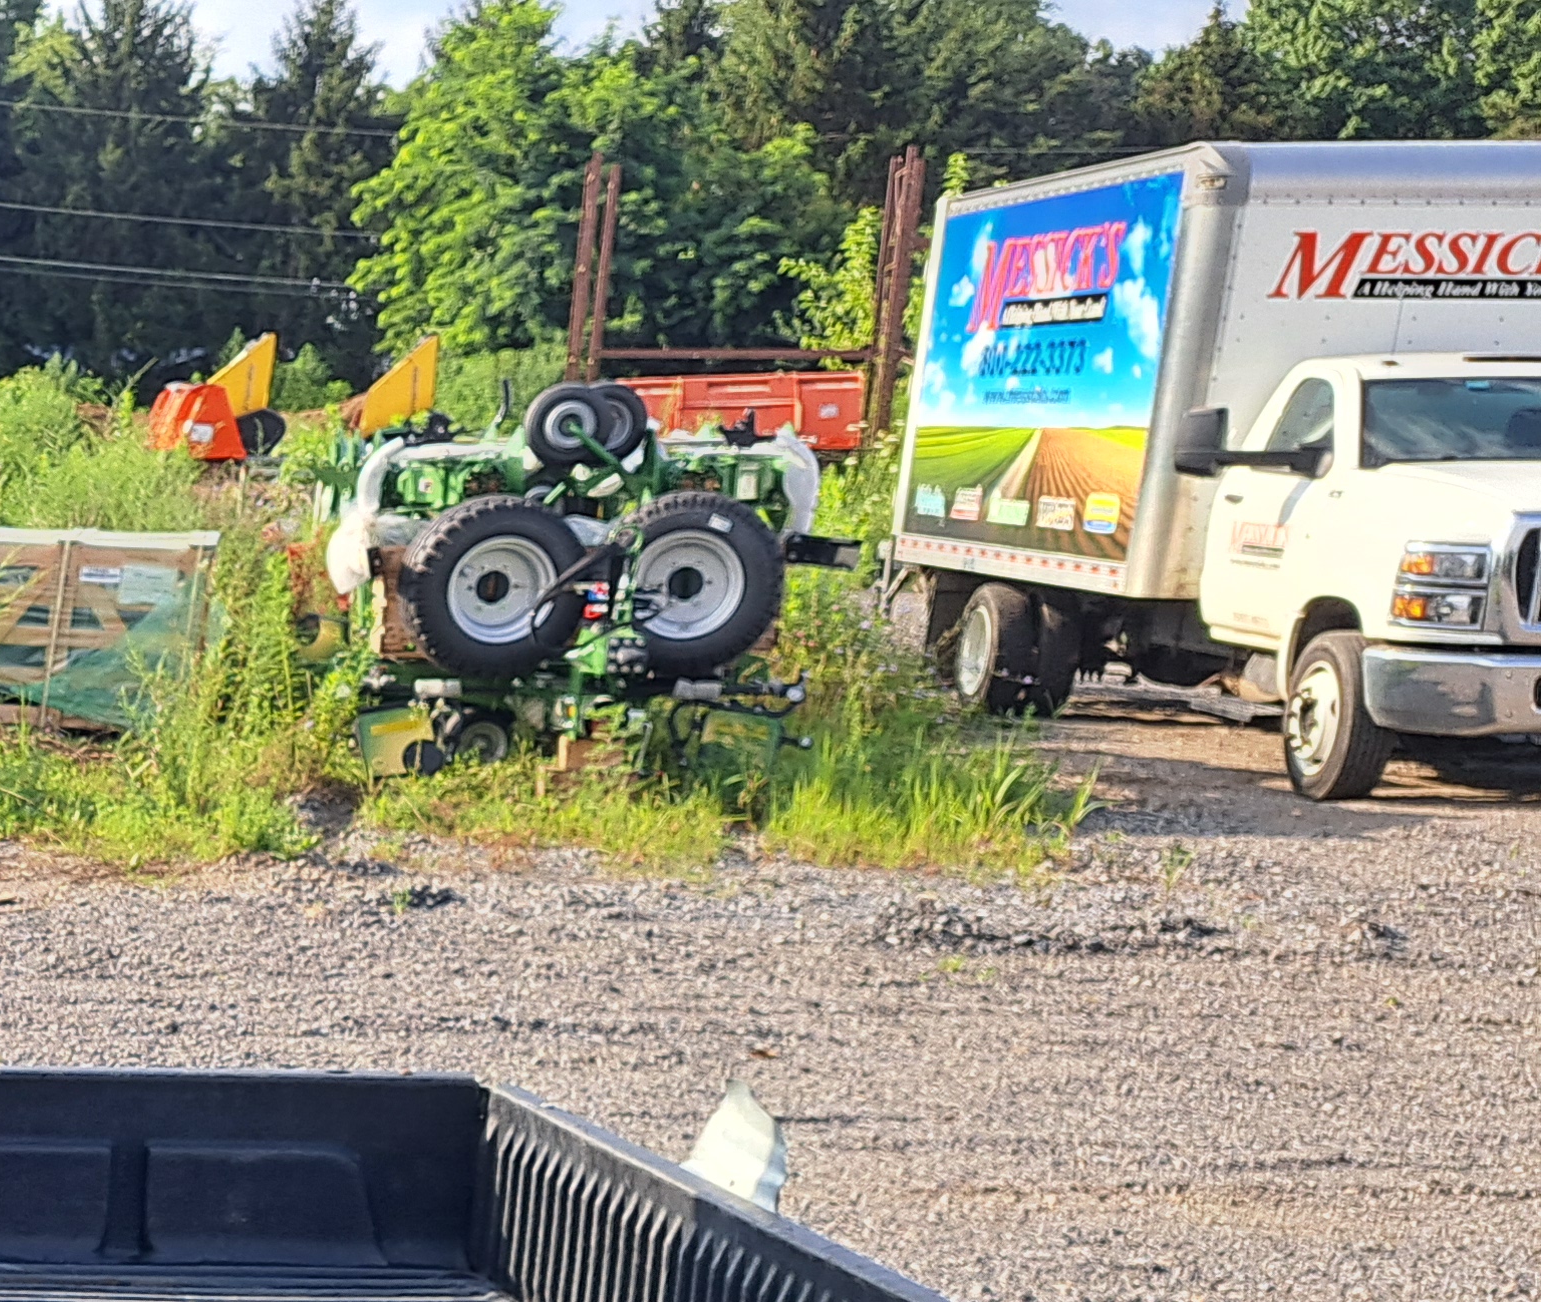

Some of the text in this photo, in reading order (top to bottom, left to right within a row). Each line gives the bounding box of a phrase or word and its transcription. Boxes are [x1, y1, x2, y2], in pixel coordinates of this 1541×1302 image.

[965, 221, 1127, 333] MESSICK'S
[1266, 230, 1541, 299] MESSIC
[1373, 281, 1435, 298] Helping
[1437, 281, 1483, 297] Hand
[1483, 281, 1520, 297] With
